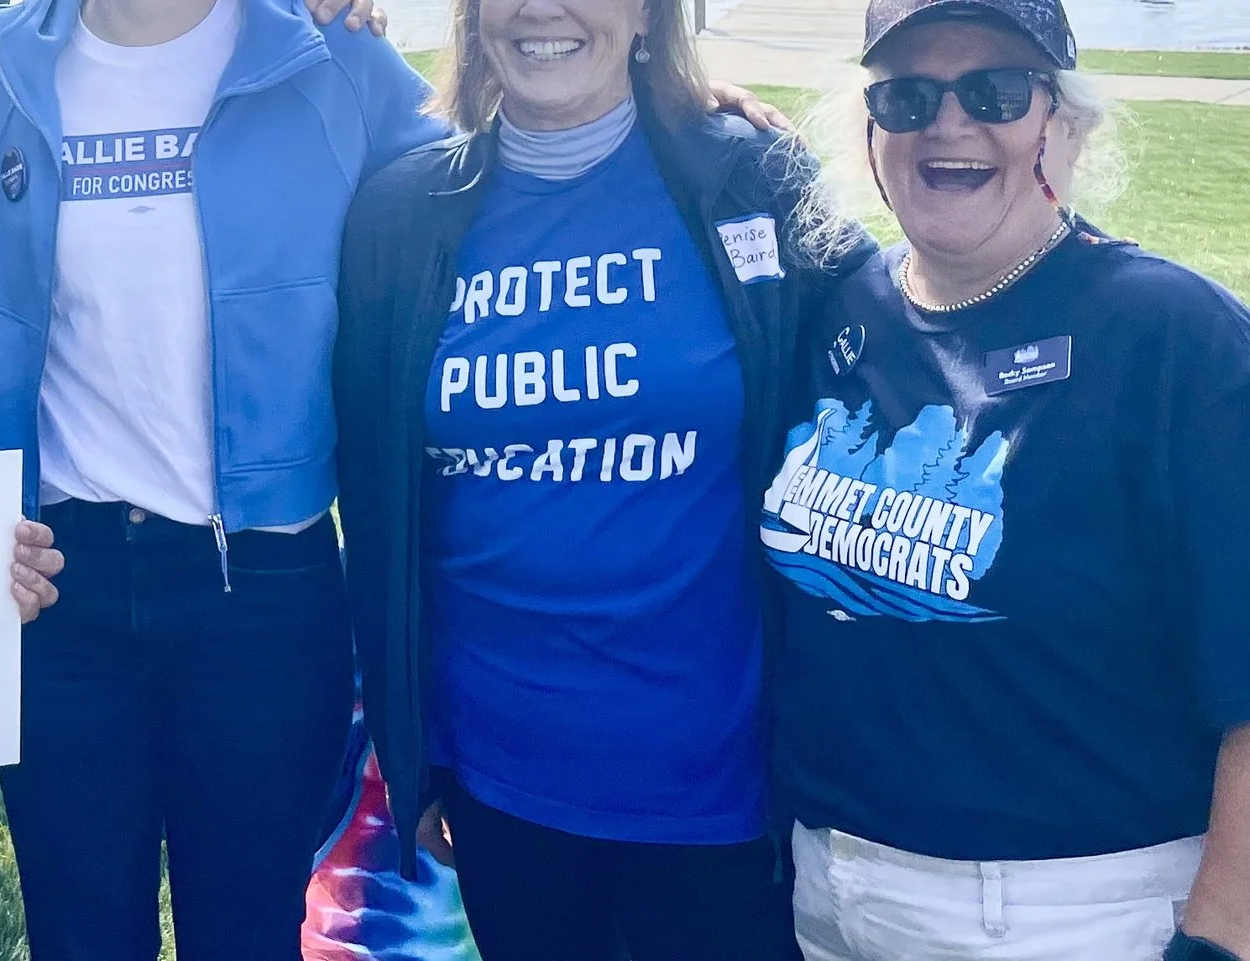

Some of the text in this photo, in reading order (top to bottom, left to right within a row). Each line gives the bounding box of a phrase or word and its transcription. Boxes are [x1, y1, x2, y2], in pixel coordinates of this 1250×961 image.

[61, 136, 146, 165] ALLIE
[72, 176, 103, 196] FOR
[719, 226, 768, 246] enise
[441, 342, 640, 412] PUBLIC
[782, 465, 995, 556] EMMET COUNTY
[803, 510, 973, 601] DEMOCRATS
